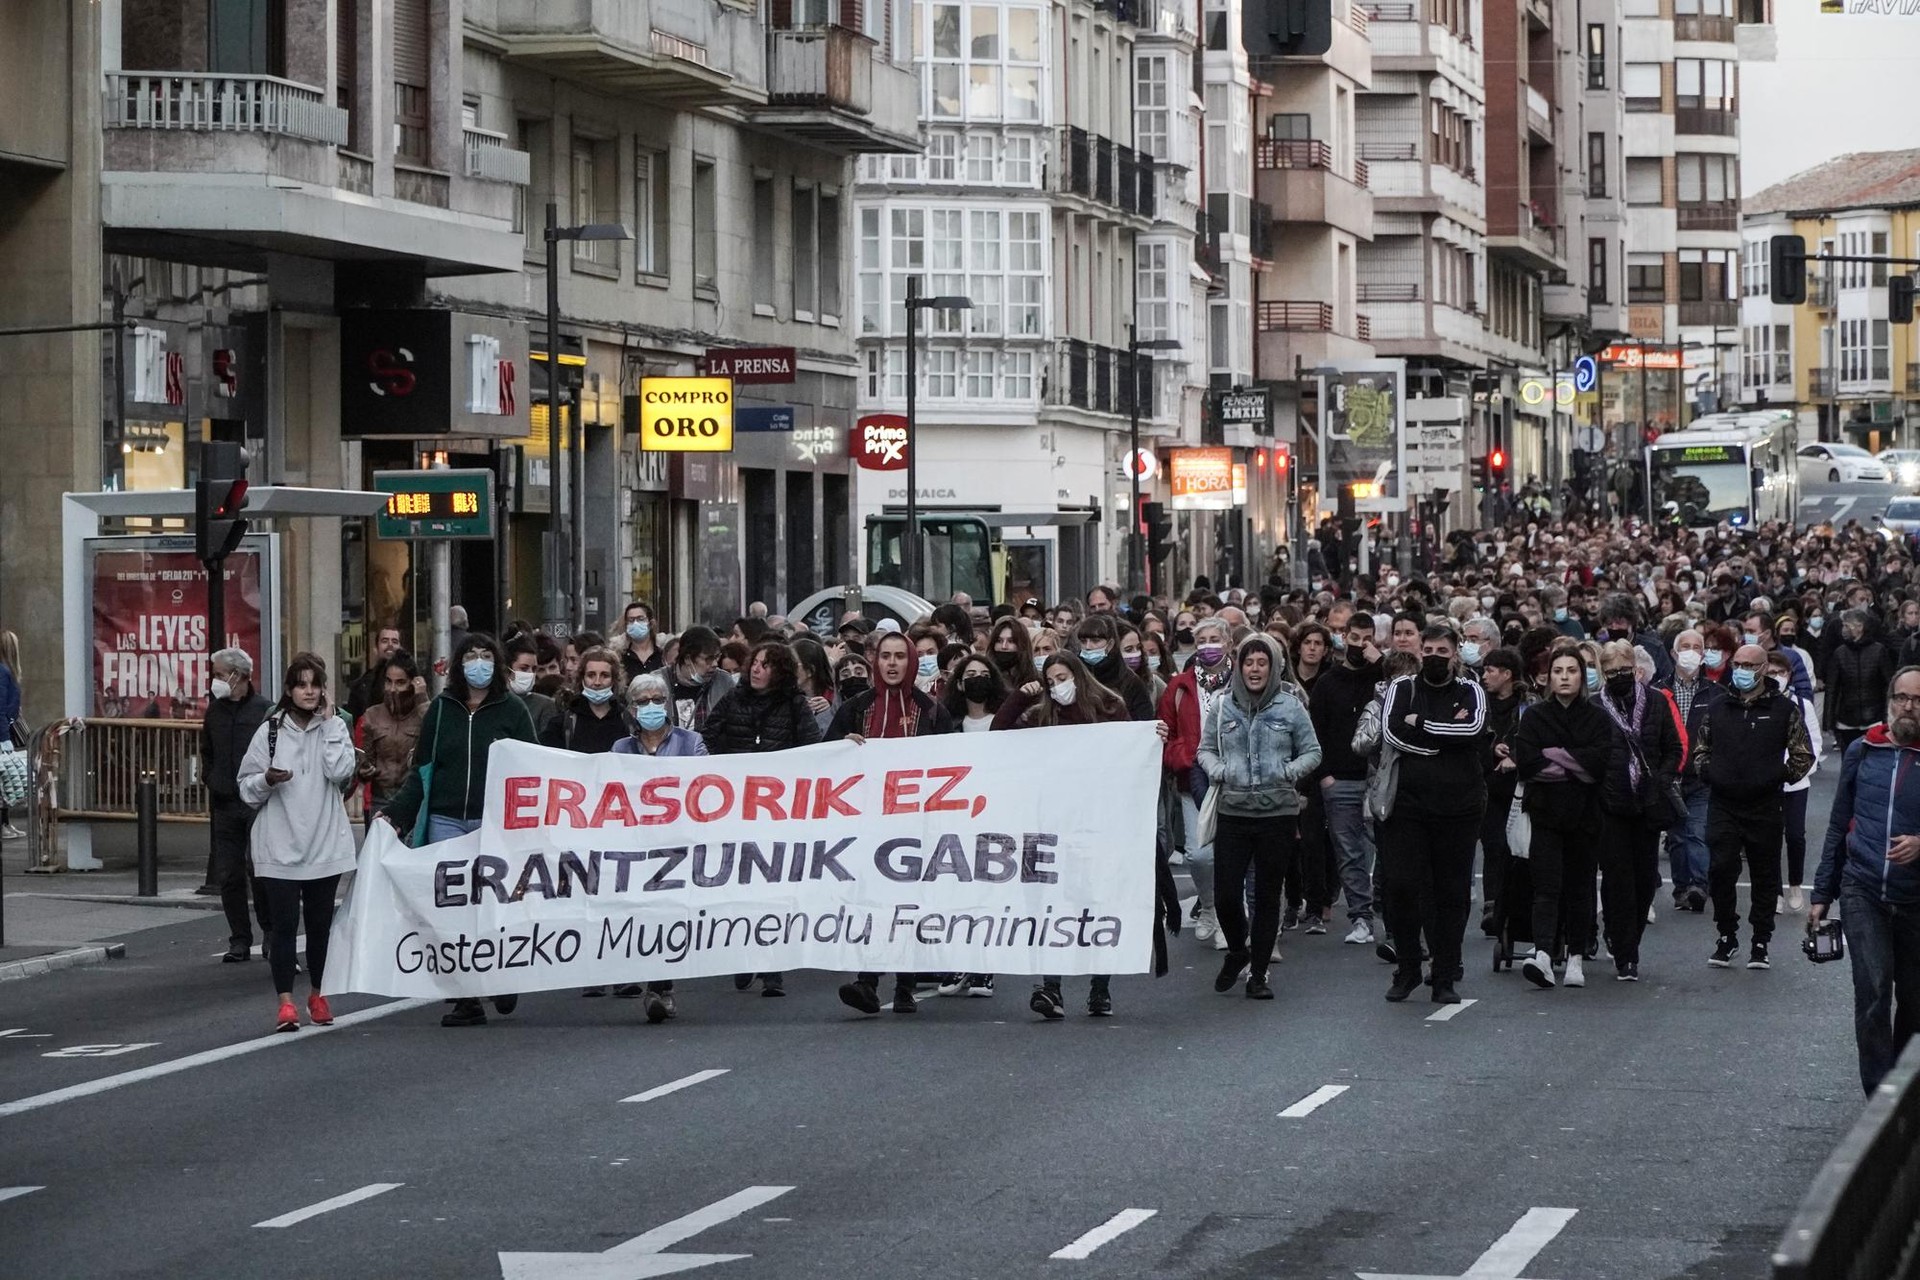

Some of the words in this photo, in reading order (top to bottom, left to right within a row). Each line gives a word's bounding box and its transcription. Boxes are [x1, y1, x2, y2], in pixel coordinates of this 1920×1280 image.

[711, 360, 729, 374] LA
[734, 358, 790, 373] PRENSA
[645, 391, 728, 404] COMPRO
[654, 417, 719, 437] ORO
[864, 425, 907, 441] Prima
[1186, 476, 1230, 492] HORA
[117, 633, 136, 650] LAS
[140, 615, 205, 651] LEYES
[226, 633, 240, 650] LA
[504, 774, 865, 830] ERASORIK
[882, 766, 987, 818] EZ,
[434, 836, 858, 908] ERANTZUNIK
[873, 832, 1059, 884] GABE
[396, 922, 582, 976] Gasteizko
[597, 904, 873, 964] Mugimendu
[888, 904, 1122, 949] Feminista
